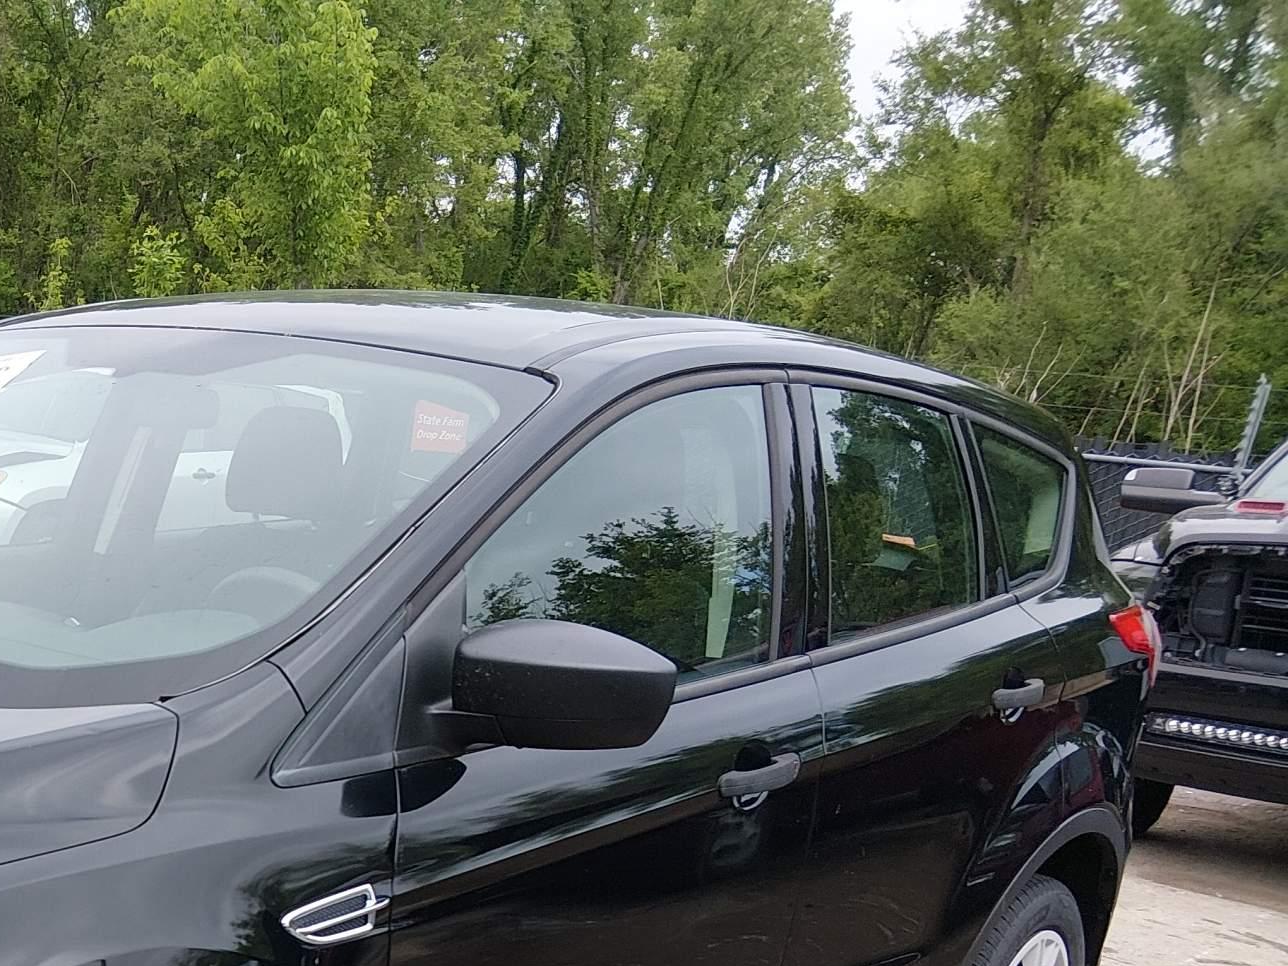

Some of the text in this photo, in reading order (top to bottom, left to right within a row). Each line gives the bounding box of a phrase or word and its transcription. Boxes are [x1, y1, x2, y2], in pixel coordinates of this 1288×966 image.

[416, 413, 464, 427] State Farm
[416, 429, 464, 440] Drop Zone
